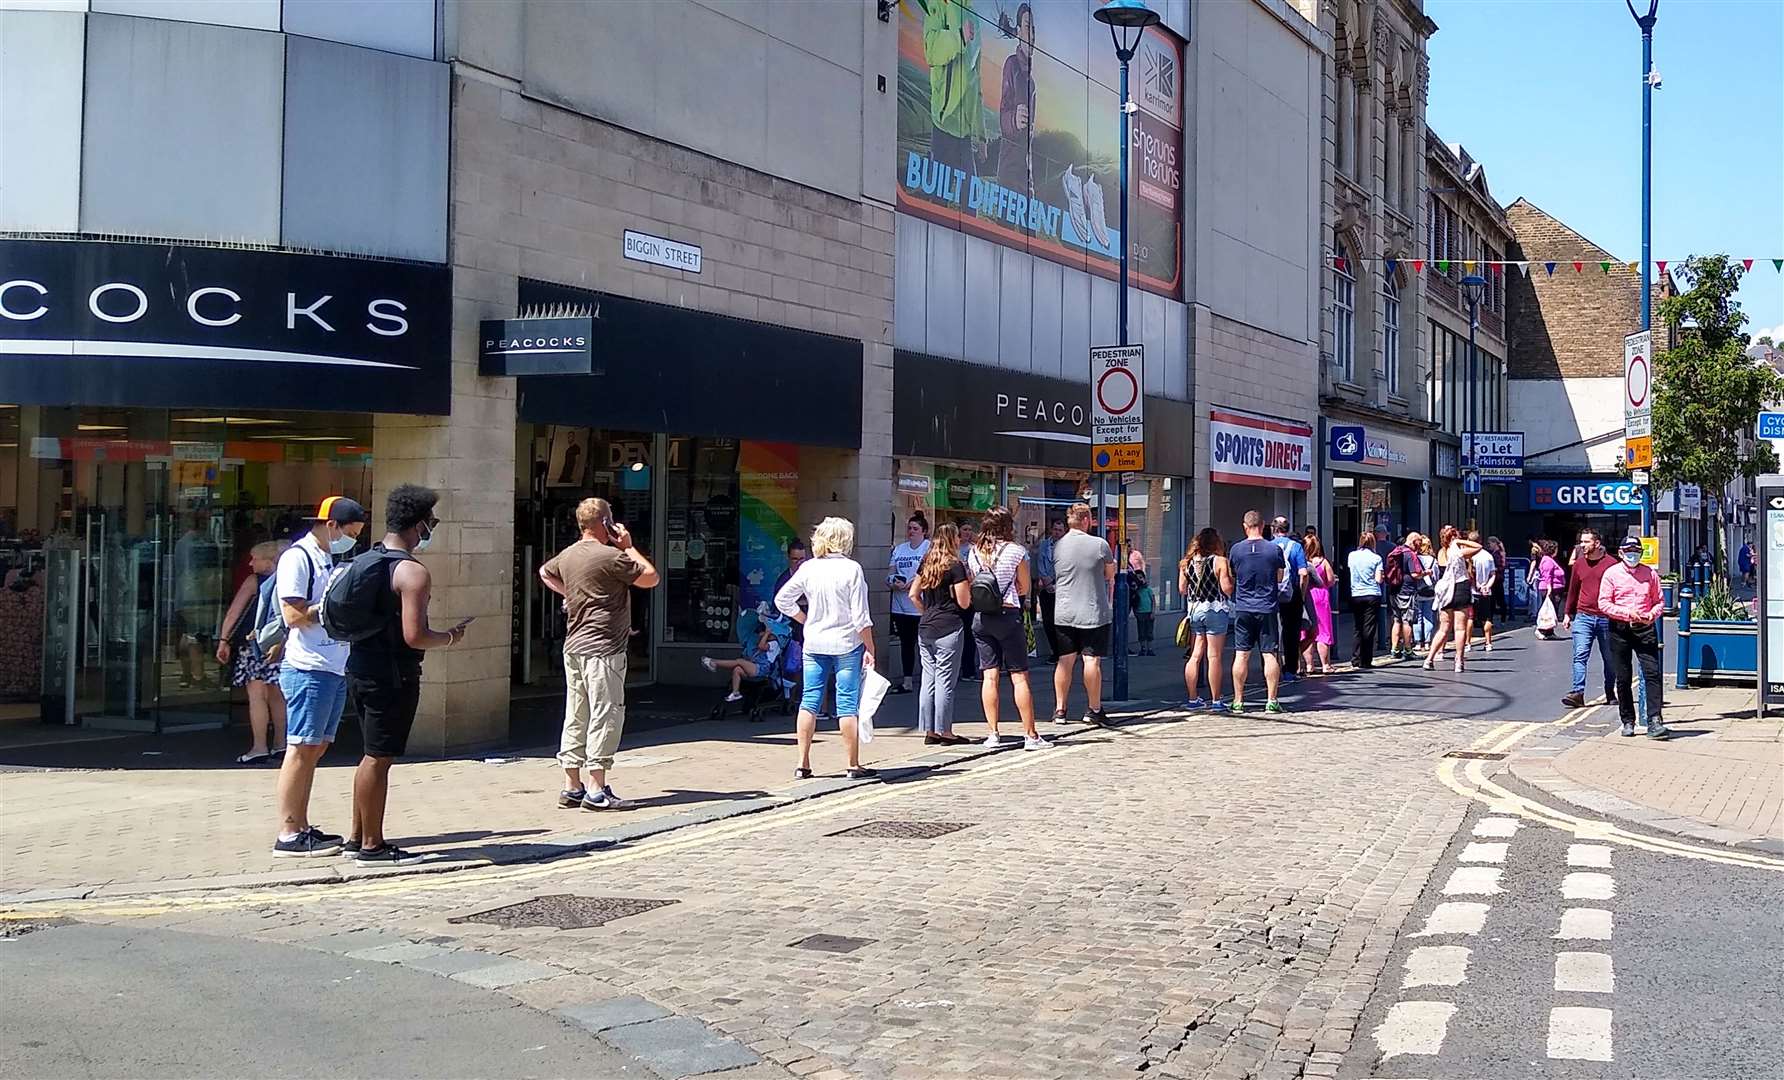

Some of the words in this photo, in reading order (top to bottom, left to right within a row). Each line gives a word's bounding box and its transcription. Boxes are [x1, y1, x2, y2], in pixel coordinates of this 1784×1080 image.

[907, 151, 966, 204] BUILT
[968, 175, 1061, 237] DIFFERENT
[626, 237, 661, 257] BIGGIN
[664, 246, 699, 266] STREET
[485, 336, 586, 349] PEACOCKS
[1092, 348, 1142, 360] PEDESTRIAN
[1105, 358, 1129, 368] ZONE
[996, 393, 1092, 427] PEACO
[1093, 416, 1106, 425] No
[1108, 414, 1141, 425] Vehicles
[1096, 425, 1124, 438] Except
[1127, 424, 1140, 434] for
[1104, 435, 1132, 443] access
[1113, 448, 1125, 458] At
[1126, 449, 1141, 460] any
[1492, 441, 1513, 455] Let
[1118, 458, 1136, 467] time
[1556, 484, 1643, 505] GREGGS
